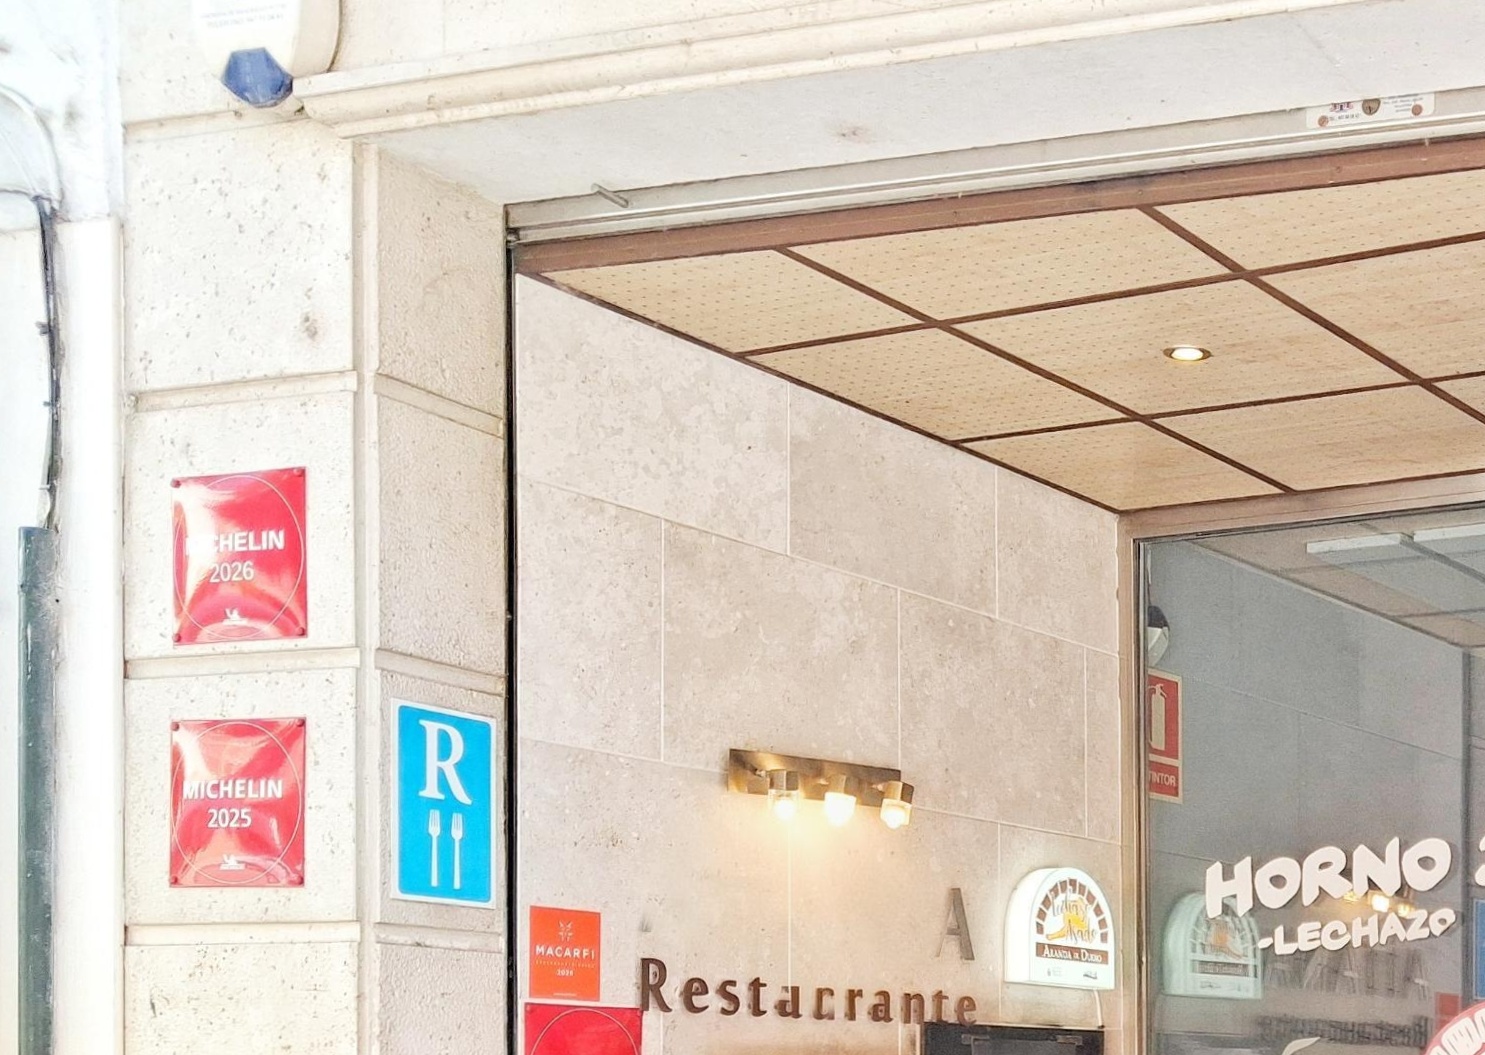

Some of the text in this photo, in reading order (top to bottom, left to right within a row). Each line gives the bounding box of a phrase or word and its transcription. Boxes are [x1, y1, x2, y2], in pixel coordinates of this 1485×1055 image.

[209, 561, 255, 583] 2026
[418, 719, 472, 806] R
[183, 778, 283, 799] MICHELIN
[207, 808, 252, 828] 2025
[1204, 836, 1451, 919] HORNO
[535, 944, 595, 960] MACARFI
